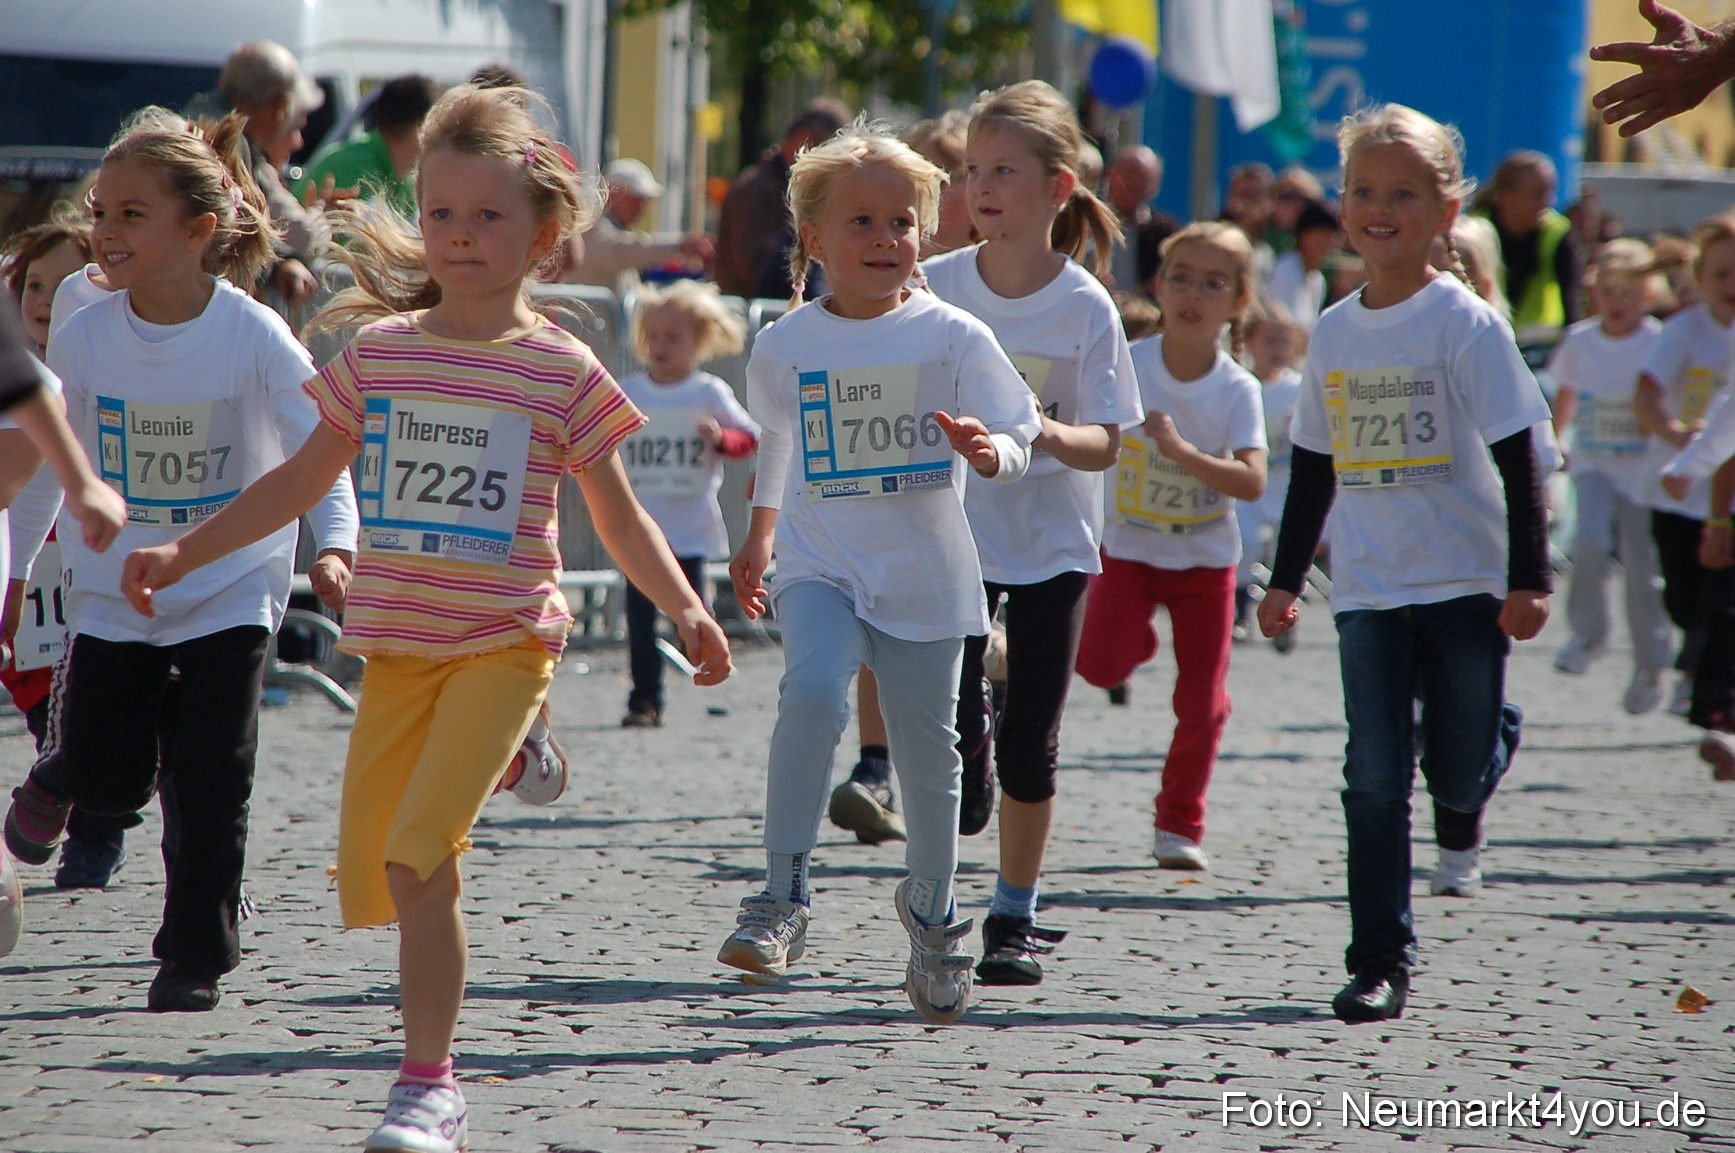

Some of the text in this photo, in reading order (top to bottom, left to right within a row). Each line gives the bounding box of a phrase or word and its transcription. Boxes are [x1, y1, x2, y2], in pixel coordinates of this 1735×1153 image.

[836, 379, 882, 403] Lara
[1349, 376, 1435, 404] Magdalena
[131, 411, 194, 436] Leonie
[397, 411, 489, 448] Theresa
[842, 411, 941, 454] 7066
[1352, 411, 1437, 447] 7213
[135, 445, 231, 485] 7057
[627, 437, 704, 467] 10212
[395, 460, 508, 511] 7225
[900, 470, 952, 484] PFLEIDERER
[443, 534, 510, 555] PFLEIDERER
